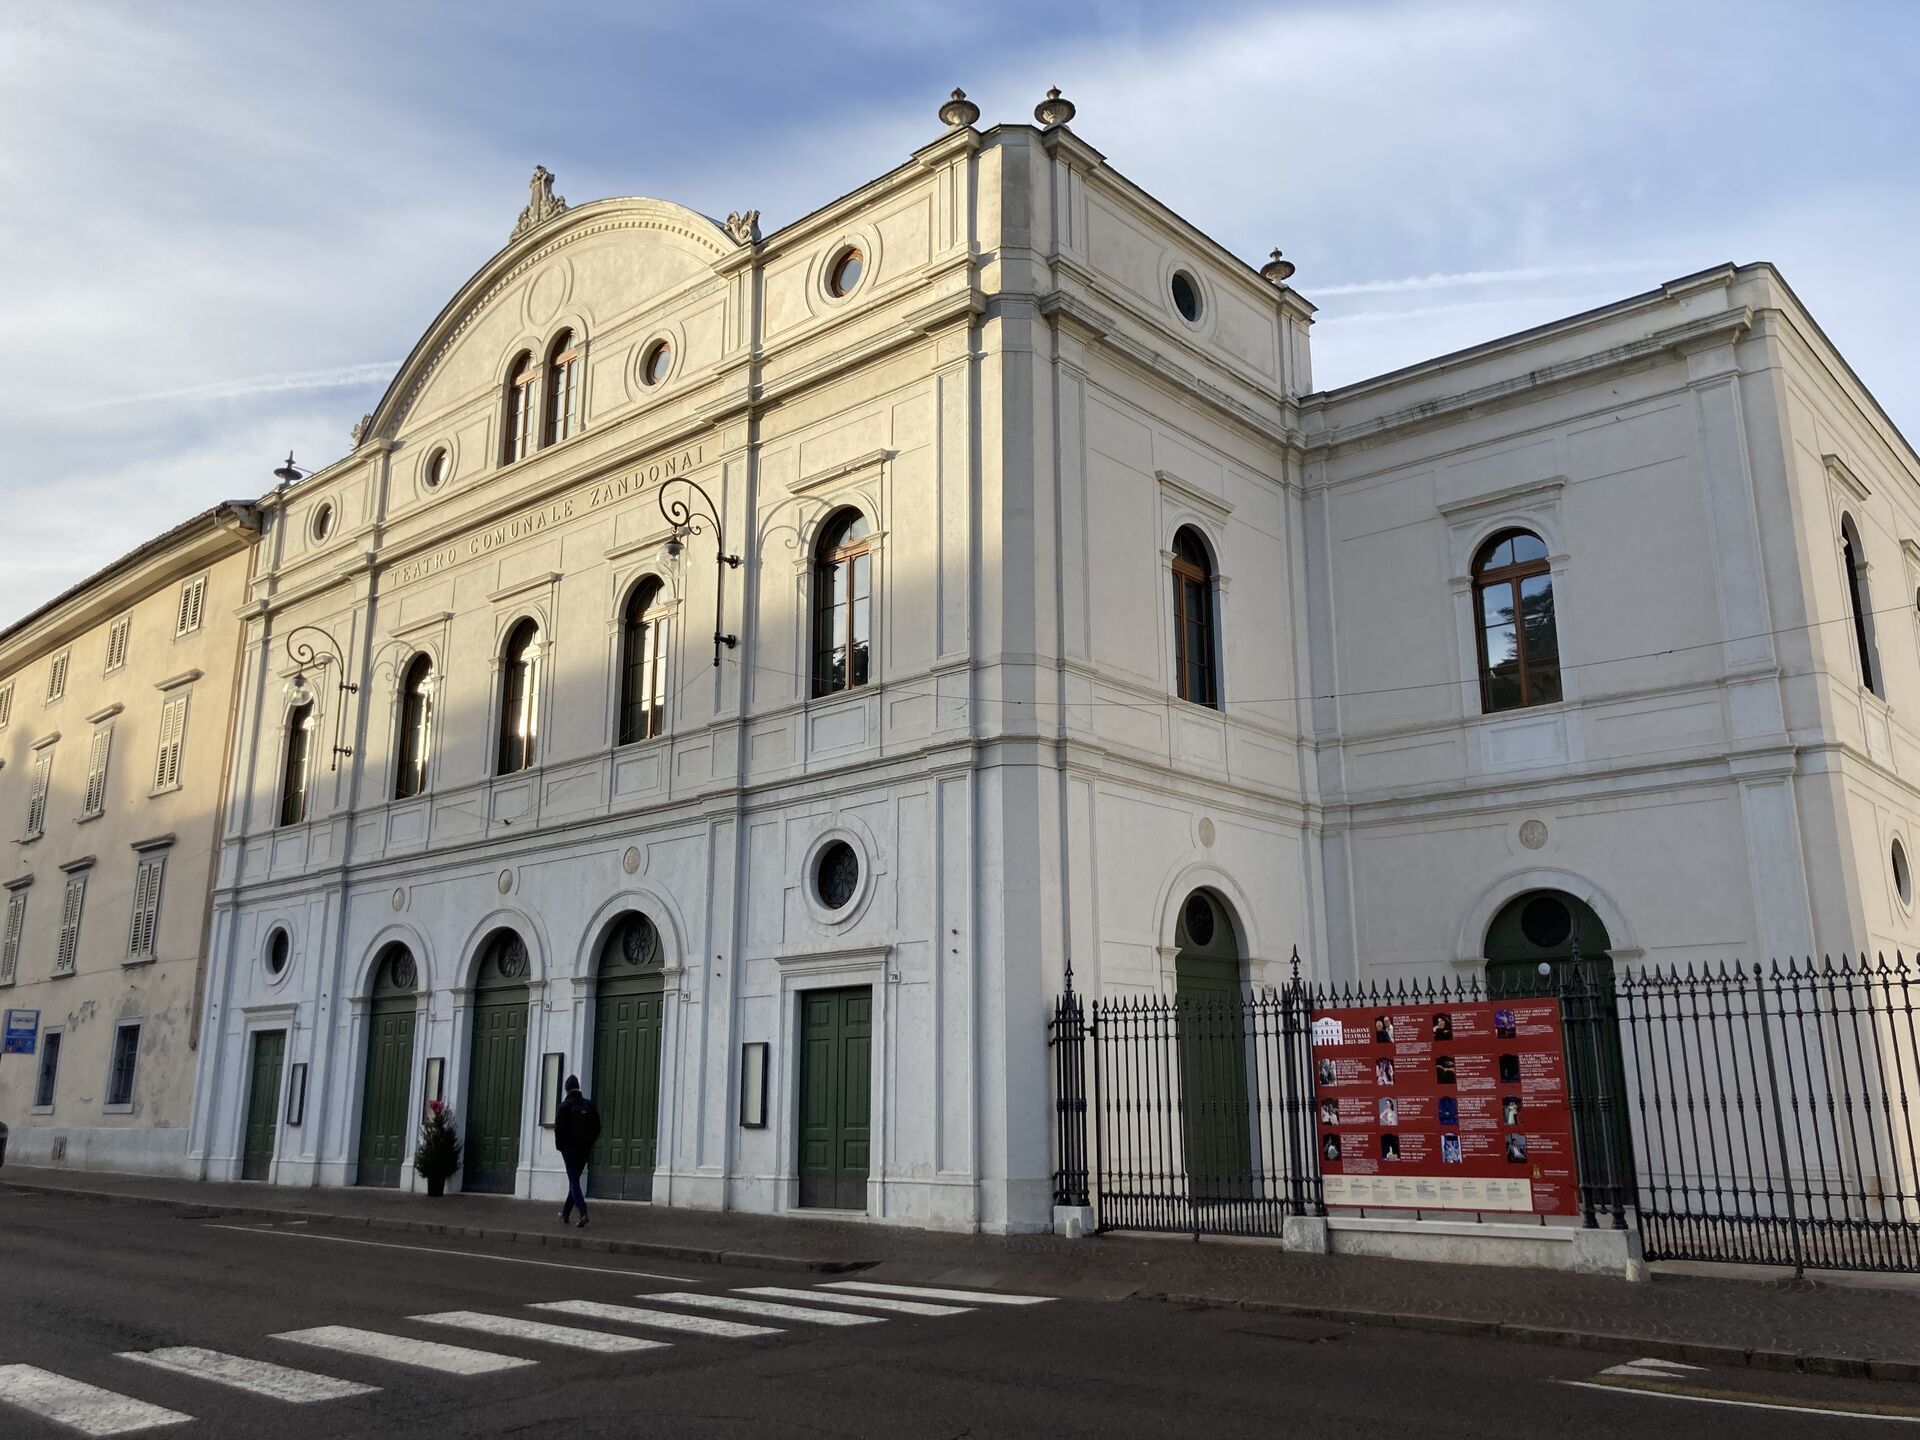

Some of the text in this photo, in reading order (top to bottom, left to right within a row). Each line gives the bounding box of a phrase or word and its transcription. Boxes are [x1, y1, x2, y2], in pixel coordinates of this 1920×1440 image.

[391, 445, 703, 586] TEATRO COMUNALE ZANDONAI
